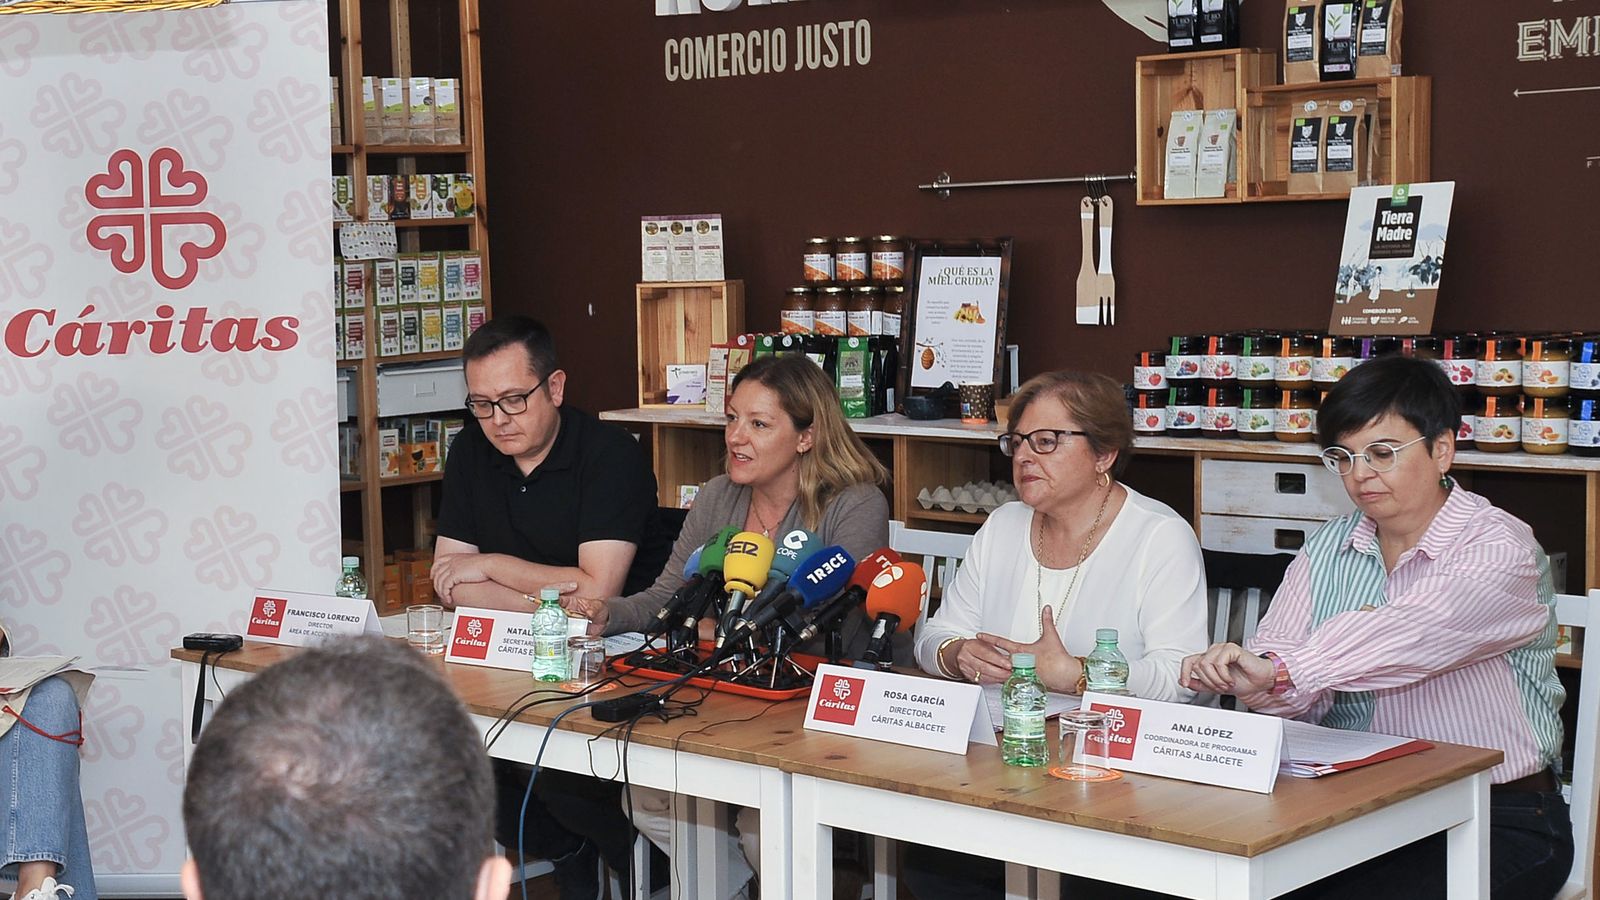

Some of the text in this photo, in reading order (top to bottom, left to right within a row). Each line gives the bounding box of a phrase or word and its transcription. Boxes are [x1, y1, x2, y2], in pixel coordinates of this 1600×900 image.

[1517, 15, 1600, 61] EM
[664, 18, 872, 82] COMERCIO JUSTO
[1381, 210, 1414, 225] Tierra
[1376, 226, 1412, 241] Madre
[939, 264, 993, 279] ¿QUÉ ES LA
[928, 276, 995, 286] MIEL CRUDA?
[4, 304, 300, 358] Cáritas
[776, 547, 798, 560] COPE
[287, 608, 360, 623] FRANCISCO LORENZO
[307, 621, 333, 629] DIRECTOR
[455, 636, 487, 648] Cáritas
[497, 644, 528, 656] CÁRITAS
[818, 698, 856, 711] Cáritas
[883, 690, 945, 706] ROSA GARCÍA
[889, 705, 933, 719] DIRECTORA
[871, 714, 946, 733] CÁRITAS ALBACETE
[1171, 723, 1233, 740] ANA LÓPEZ
[1144, 733, 1257, 756] COORDINADORA DE PROGRAMAS
[1153, 744, 1244, 767] CÁRITAS ALBACETE
